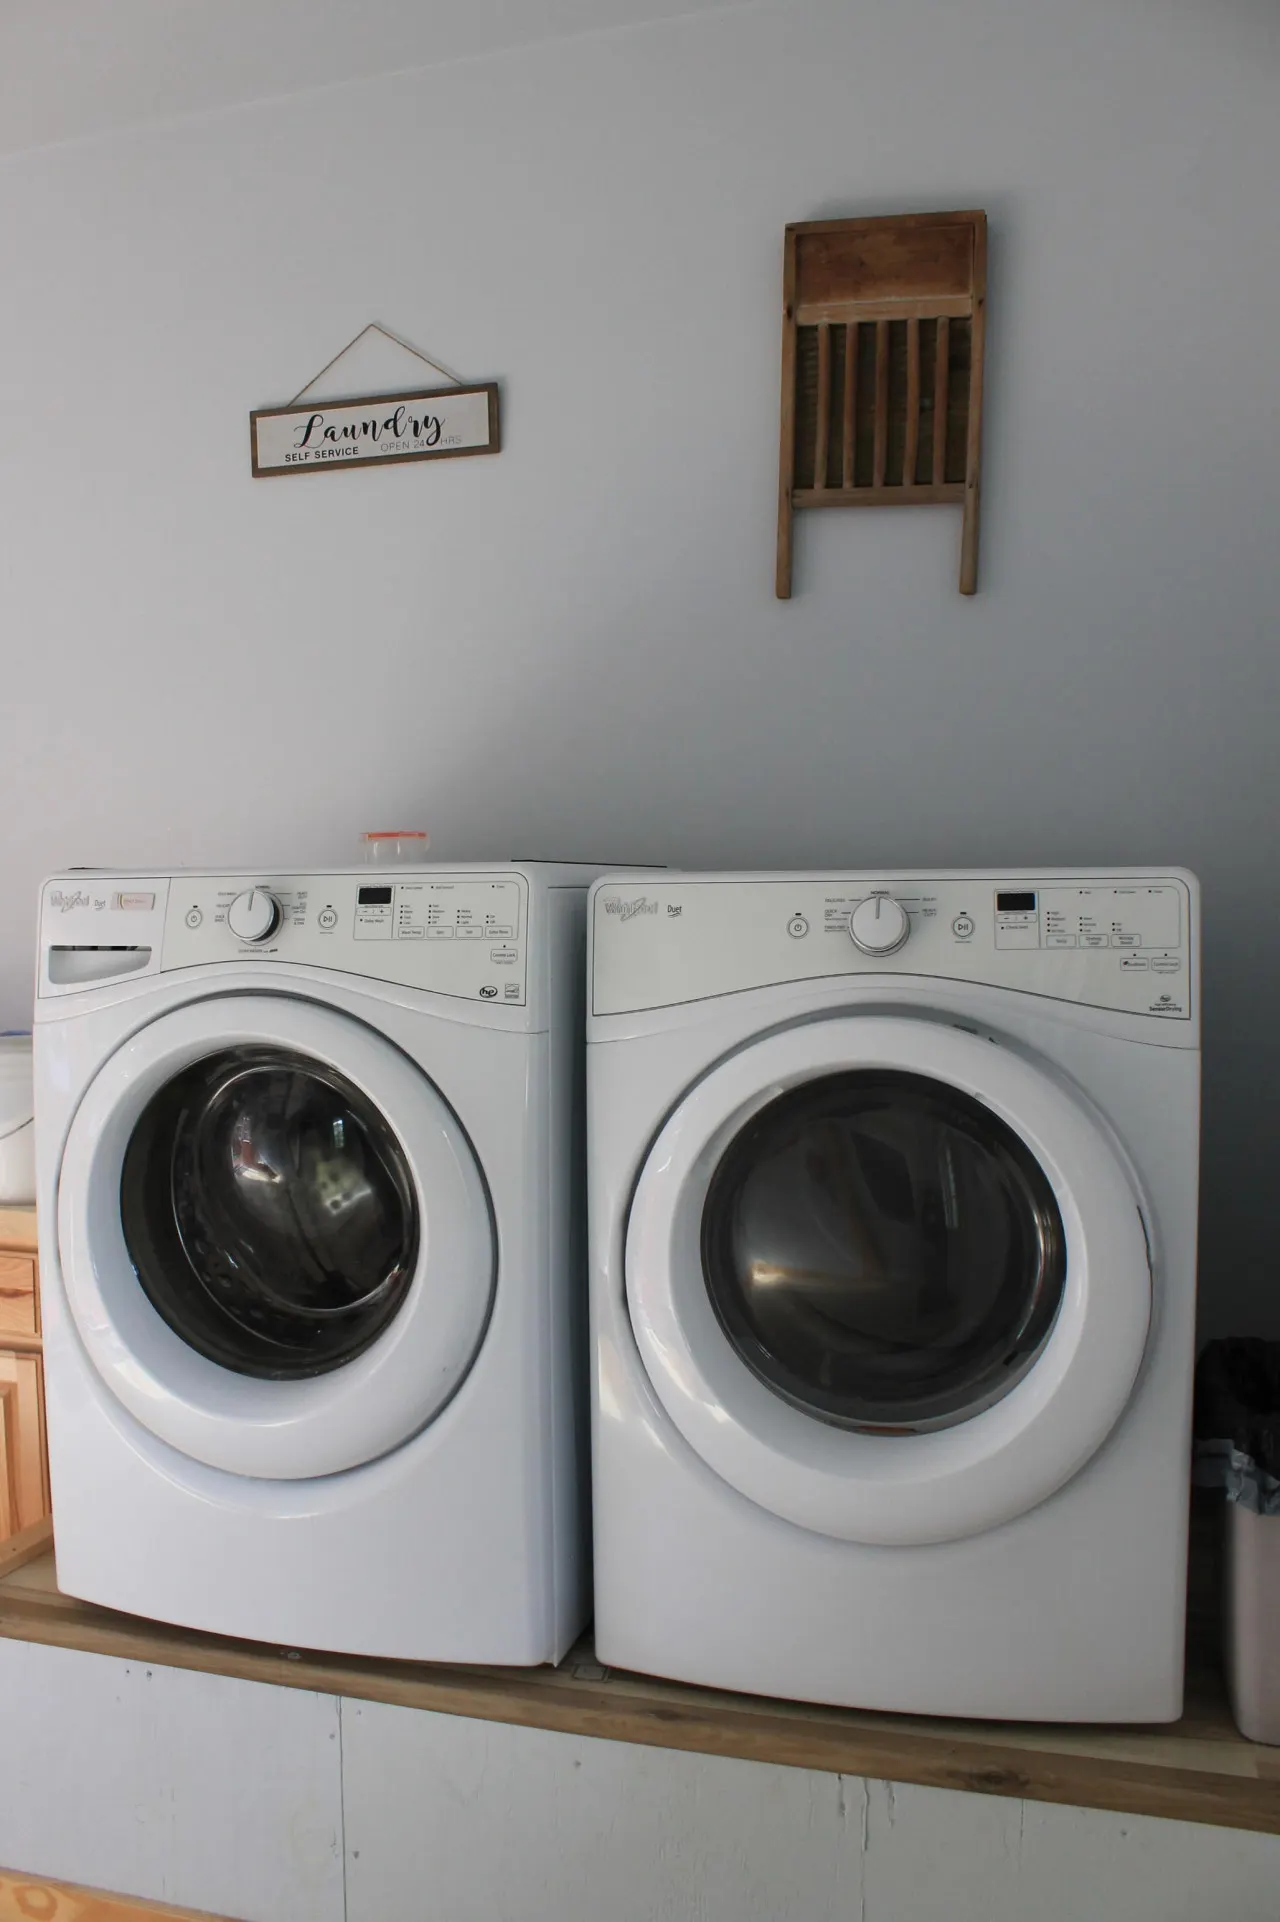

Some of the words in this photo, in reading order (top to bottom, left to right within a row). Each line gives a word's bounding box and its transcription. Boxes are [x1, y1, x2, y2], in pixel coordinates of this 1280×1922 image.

[293, 406, 446, 449] Laundry
[380, 442, 410, 453] OPEN
[413, 438, 425, 449] 24
[440, 435, 462, 446] HRS
[285, 452, 311, 462] SELF
[314, 447, 359, 459] SERVICE
[667, 904, 682, 914] Duet
